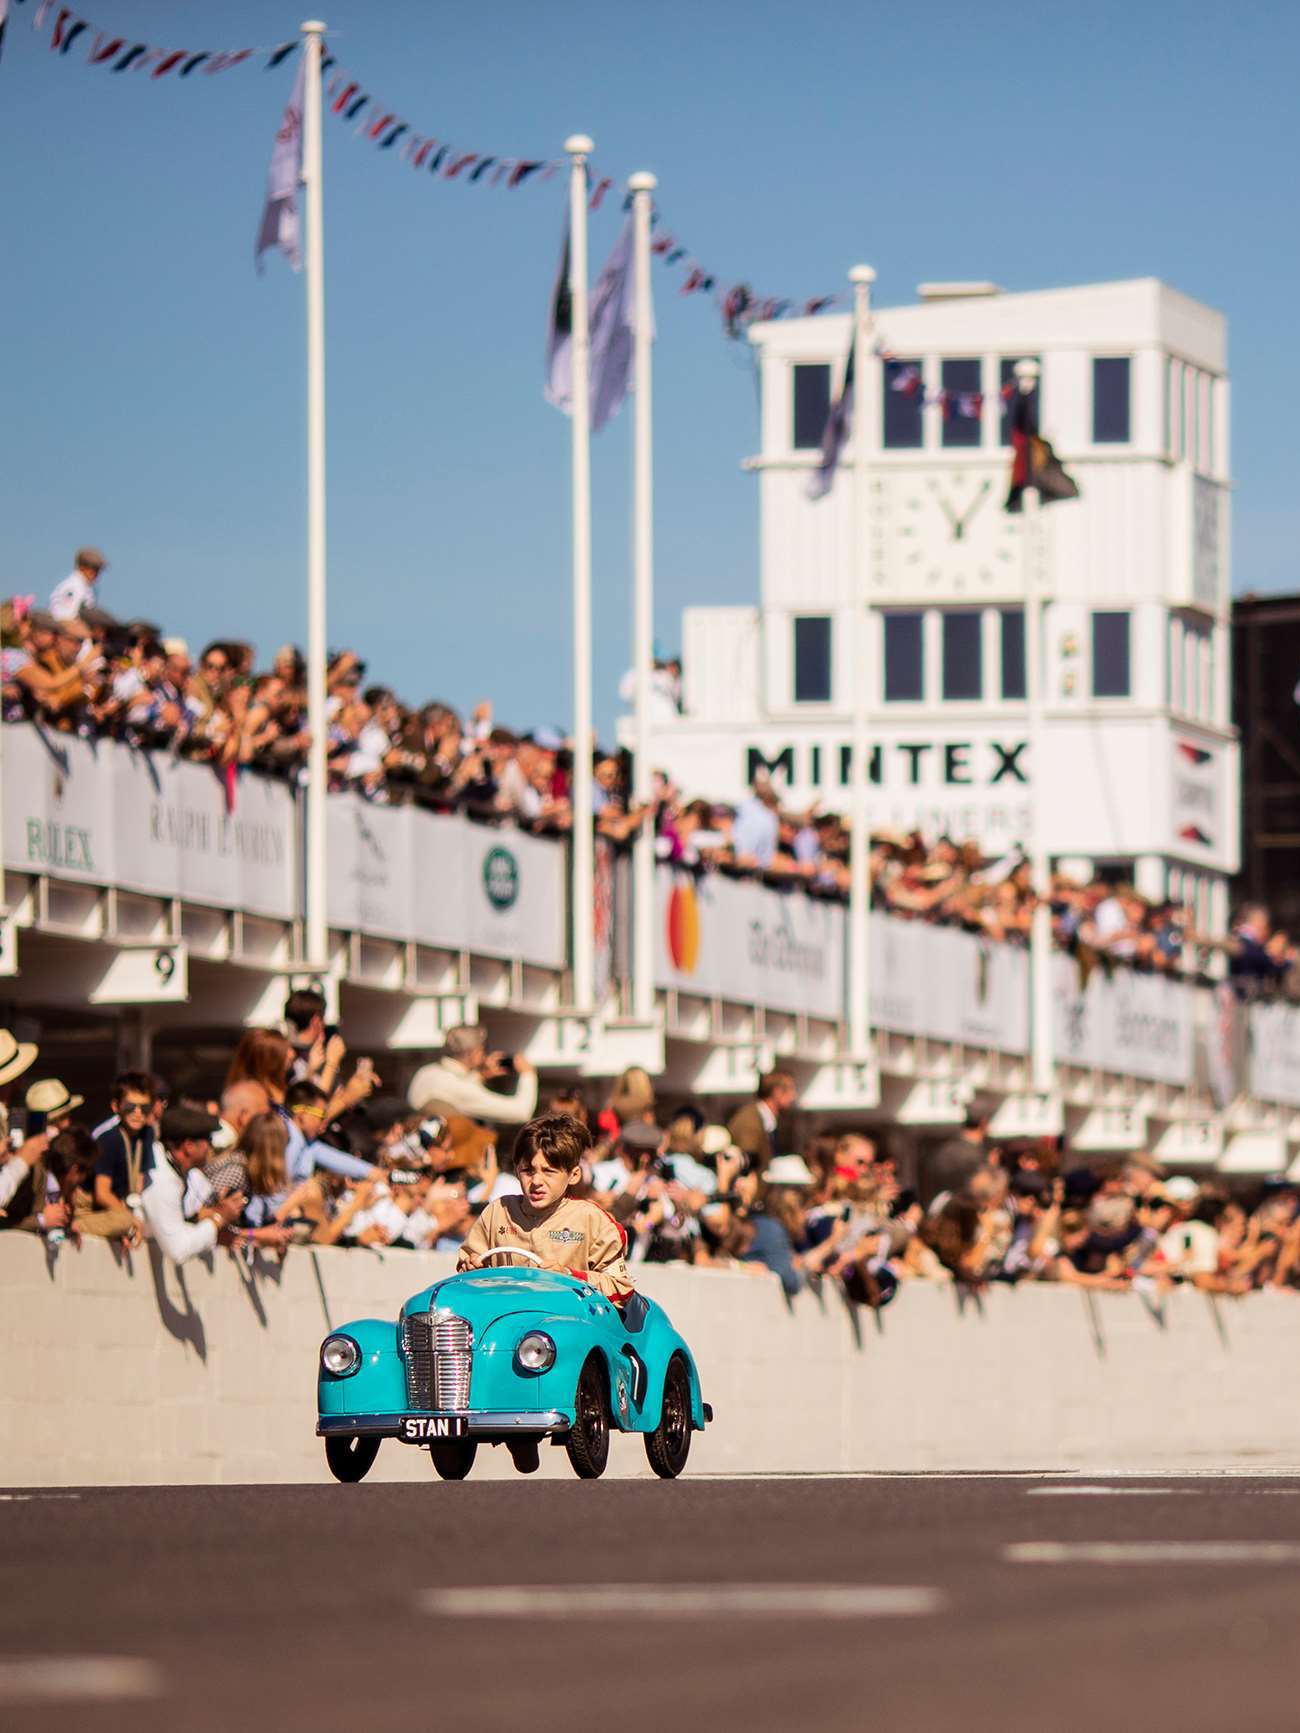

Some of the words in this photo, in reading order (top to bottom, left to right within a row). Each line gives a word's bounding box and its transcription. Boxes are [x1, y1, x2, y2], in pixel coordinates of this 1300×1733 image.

[747, 743, 1028, 786] MINTEX
[155, 951, 175, 986] 9
[556, 1018, 592, 1052] 12
[405, 1418, 449, 1437] STAN
